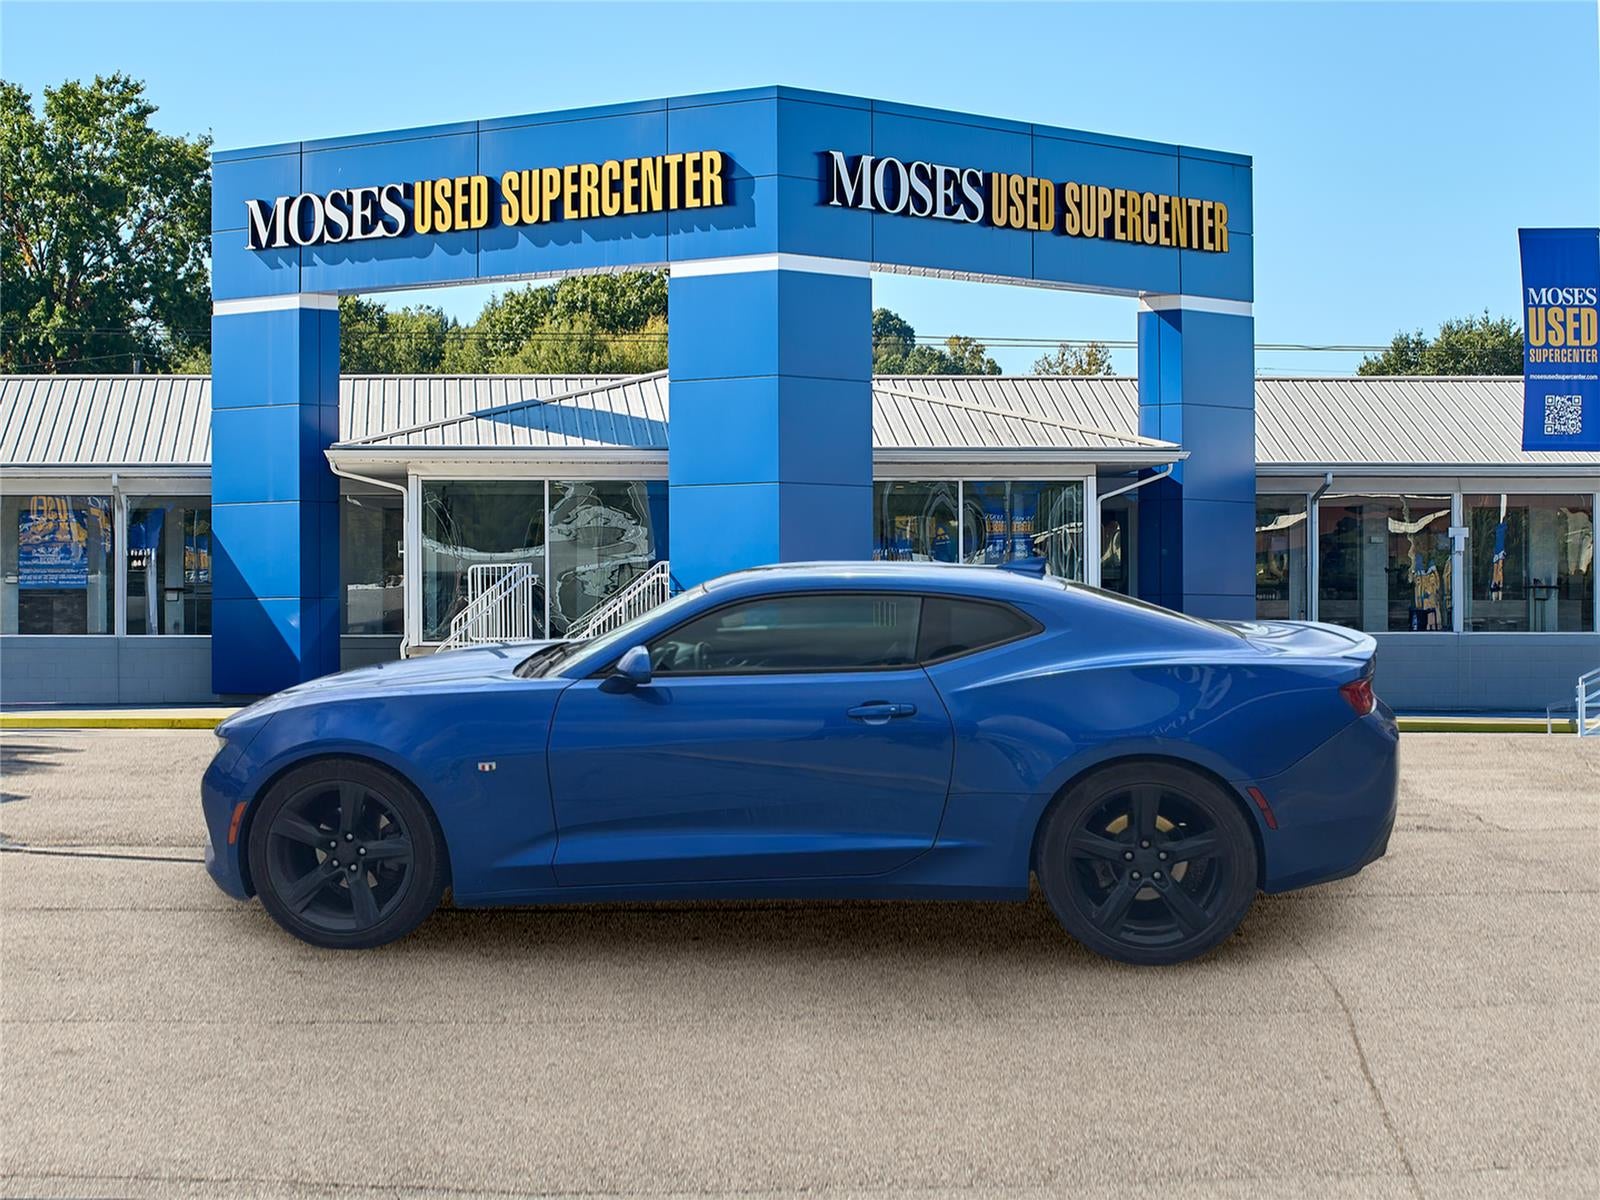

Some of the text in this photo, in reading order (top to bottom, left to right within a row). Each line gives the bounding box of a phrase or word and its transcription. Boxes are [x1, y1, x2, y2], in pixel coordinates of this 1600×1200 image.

[245, 150, 723, 250] MOSES USED SUPERCENTER
[829, 150, 1229, 253] MOSES USED SUPERCENTER
[1527, 287, 1597, 305] MOSES
[1528, 307, 1598, 347] USED
[1529, 348, 1598, 363] SUPERCENTER
